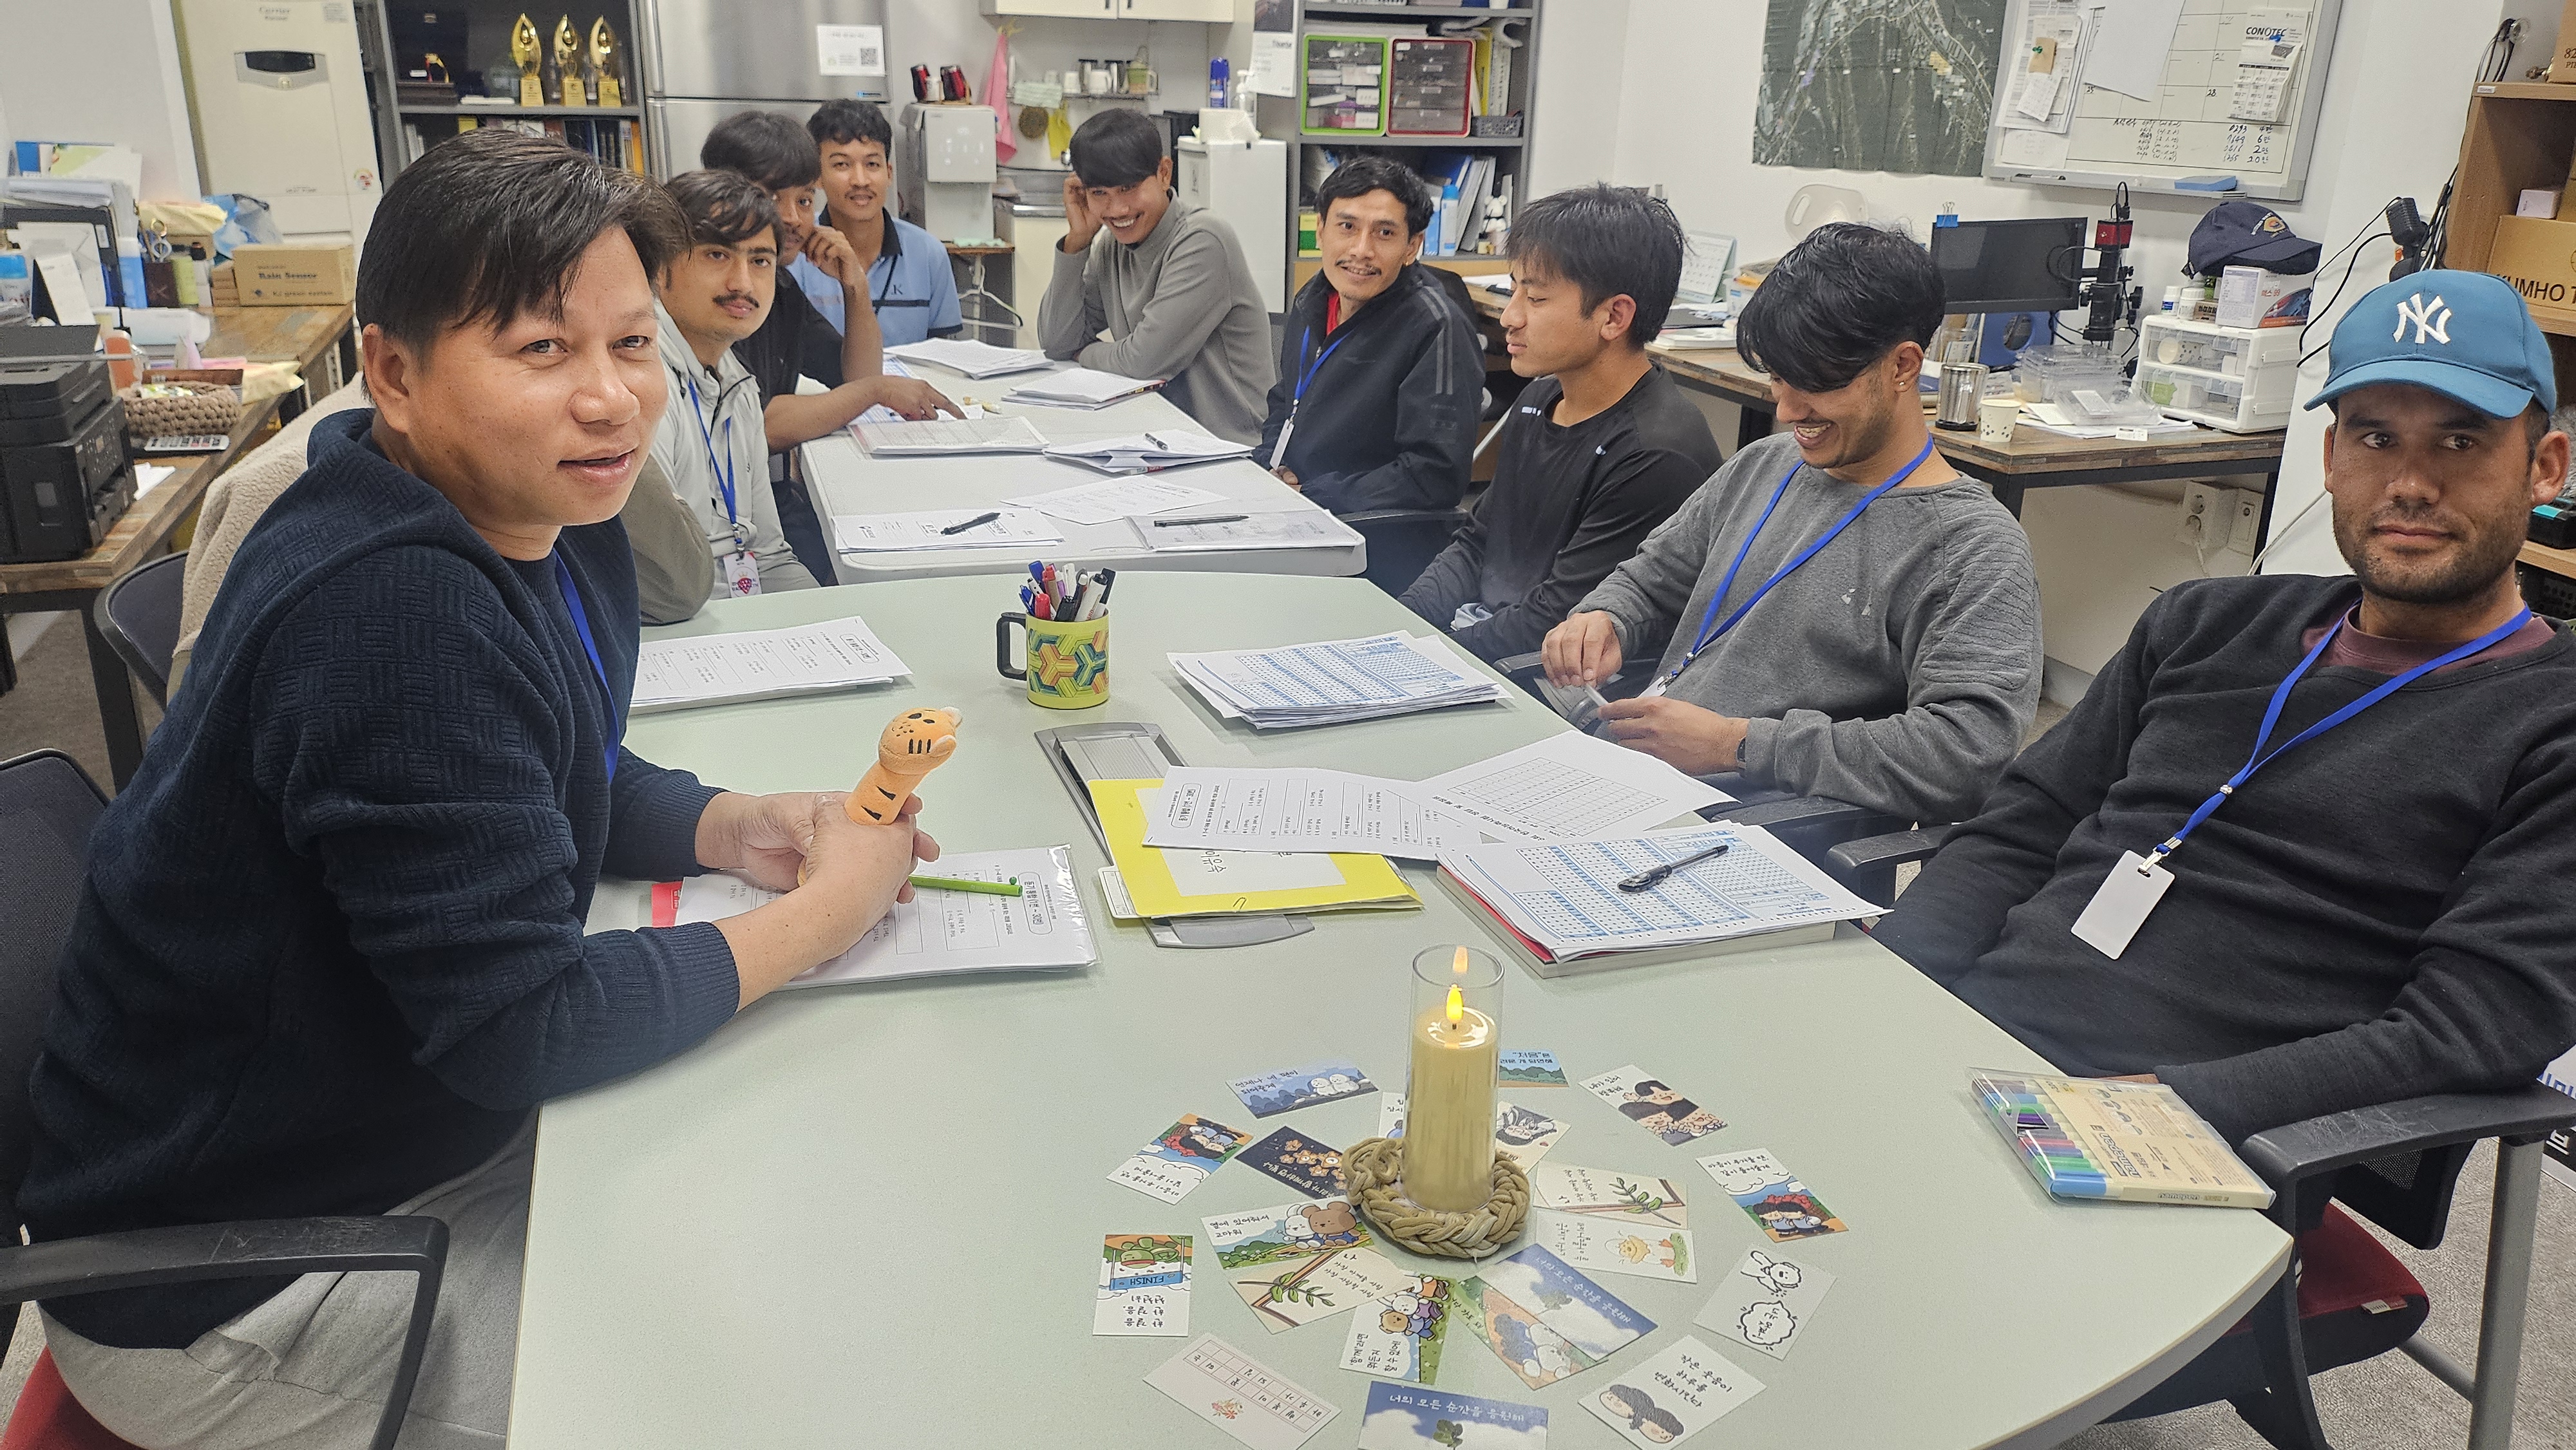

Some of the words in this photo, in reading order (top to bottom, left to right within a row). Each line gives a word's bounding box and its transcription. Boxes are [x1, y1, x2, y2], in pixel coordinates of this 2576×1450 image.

[2246, 27, 2288, 37] CONOTEC
[2206, 88, 2216, 97] 28
[2496, 274, 2565, 301] UMHO
[2392, 293, 2452, 344] NY
[1024, 881, 1036, 889] 듣기
[1025, 890, 1037, 898] 통합
[1027, 899, 1039, 907] (1번
[1234, 1078, 1264, 1089] 언제나
[1239, 1084, 1276, 1095] 되어줄게
[1734, 1156, 1755, 1165] 무거울
[2099, 1133, 2141, 1178] namepen
[1132, 1165, 1167, 1181] 들어줄게
[1738, 1165, 1770, 1174] 들어줄게
[1129, 1174, 1157, 1187] 무거울
[1162, 1177, 1184, 1188] 같이
[1278, 1169, 1311, 1188] 함께하면
[1153, 1183, 1181, 1197] 마음이
[2158, 1192, 2200, 1201] namepen
[1209, 1219, 1229, 1229] 옆에
[1232, 1214, 1270, 1227] 있어줘서
[1215, 1229, 1243, 1238] 고마워
[1332, 1261, 1350, 1270] 가장
[1321, 1268, 1340, 1277] 가장
[1130, 1275, 1164, 1285] FINISH
[1554, 1270, 1573, 1285] 모든
[1574, 1283, 1602, 1304] 순간을
[1131, 1295, 1165, 1304] 천천히
[1153, 1306, 1164, 1315] 한
[1124, 1318, 1146, 1327] 걸음
[1152, 1318, 1163, 1328] 한
[1368, 1348, 1380, 1370] 뭐든지
[1680, 1353, 1701, 1370] 작은
[1701, 1370, 1734, 1393] 웃음이
[1677, 1370, 1707, 1391] 하루를
[1654, 1371, 1703, 1409] 변화시킨다
[1389, 1395, 1414, 1404] 너의
[1417, 1398, 1441, 1409] 모든
[1446, 1402, 1482, 1417] 순간을
[1488, 1411, 1525, 1422] 응원해
